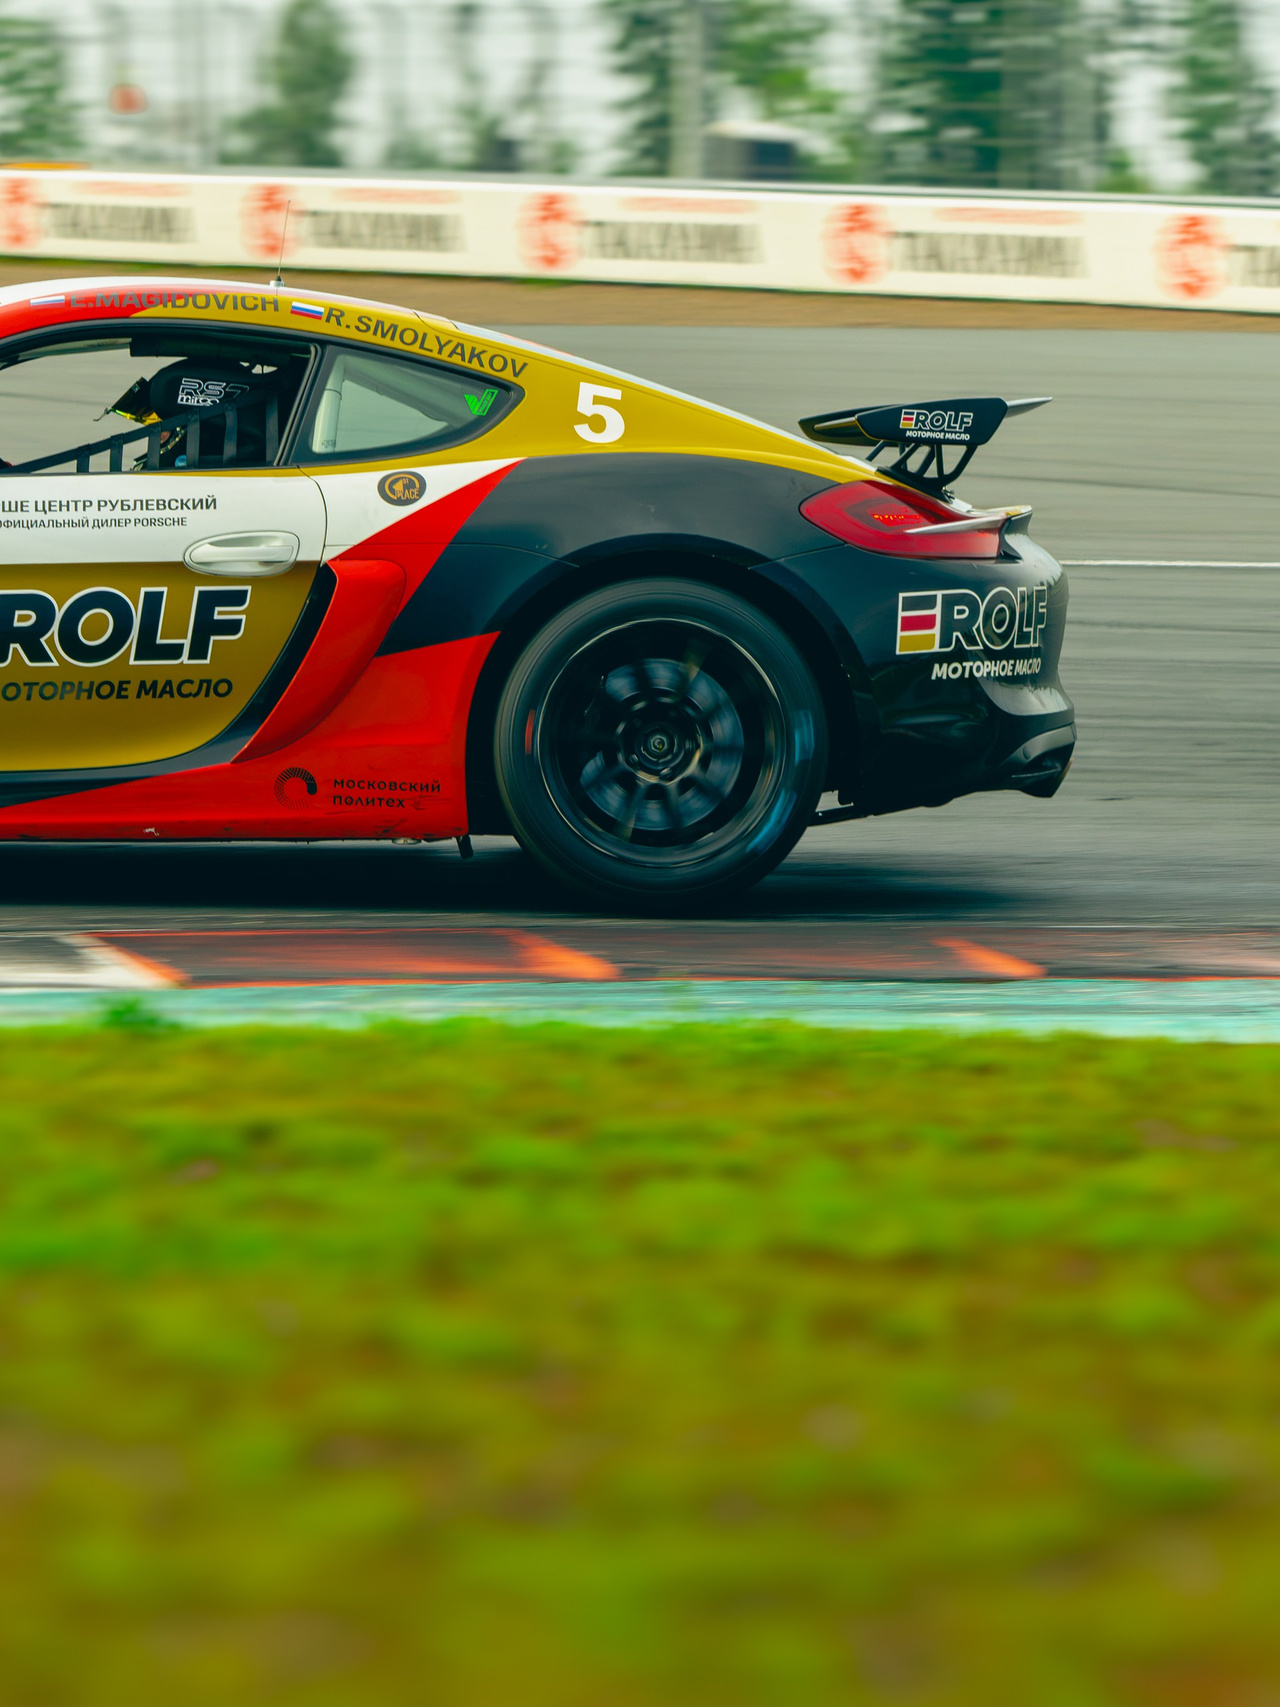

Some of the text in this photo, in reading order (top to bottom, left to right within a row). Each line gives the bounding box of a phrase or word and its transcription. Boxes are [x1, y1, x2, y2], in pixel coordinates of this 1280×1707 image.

[70, 292, 279, 312] E.MAGIDOVICH
[325, 307, 528, 378] R.SMOLYAKOV
[573, 381, 625, 443] 5
[913, 409, 974, 432] ROLF
[905, 430, 971, 441] МОТОРНОЕ МАСЛО
[34, 500, 94, 515] ЦЕНТР
[97, 495, 218, 512] РУБЛЕВСКИЙ
[91, 518, 132, 529] ДИЛЕР
[133, 517, 188, 527] PORSCHE
[937, 586, 1048, 651] ROLF
[931, 657, 1042, 681] МОТОРНОЕ МАСЛО
[135, 678, 234, 699] МАСЛО
